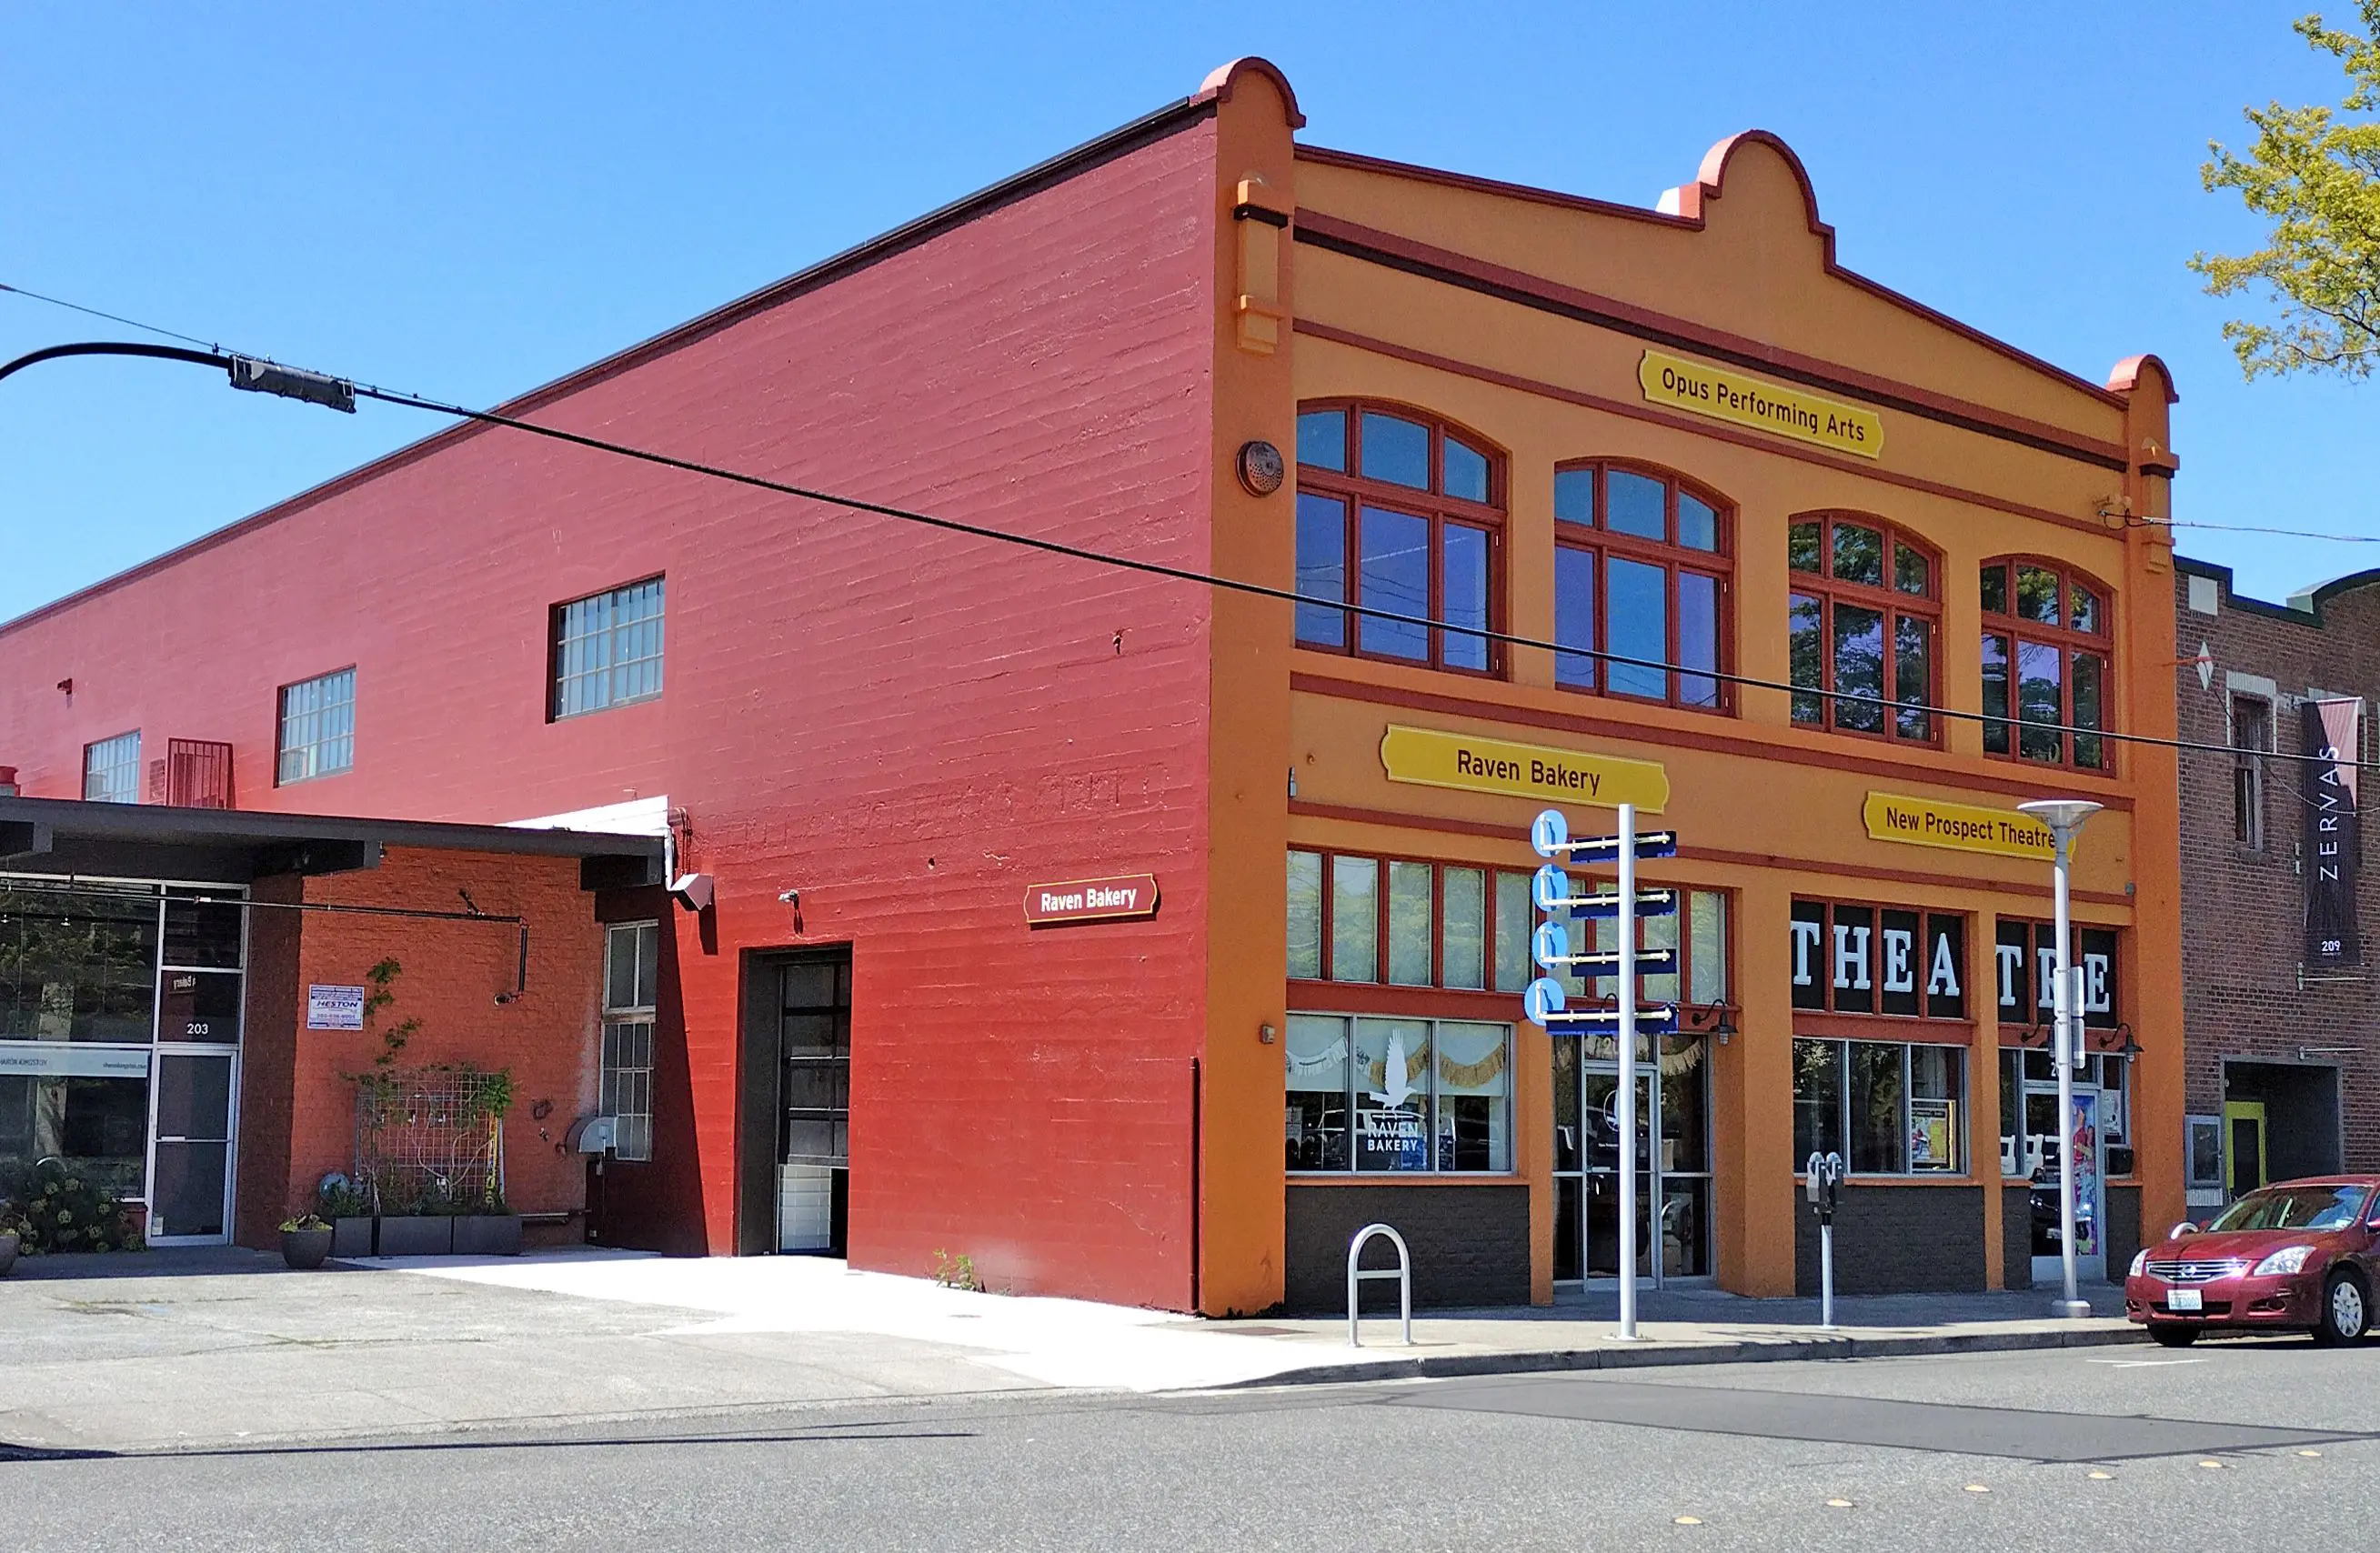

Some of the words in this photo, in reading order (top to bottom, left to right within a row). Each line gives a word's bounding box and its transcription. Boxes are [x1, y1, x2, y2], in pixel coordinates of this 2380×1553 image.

[1662, 367, 1710, 400] Opus
[1717, 382, 1818, 435] Performing
[1826, 413, 1865, 442] Arts
[1457, 748, 1521, 781] Raven
[1531, 759, 1601, 797] Bakery
[2318, 746, 2340, 881] ZERVAS
[1886, 807, 1920, 831] New
[1925, 812, 1993, 841] Prospect
[1998, 821, 2056, 849] Theatre
[1040, 892, 1083, 913] Raven
[1086, 885, 1138, 910] Bakery
[2321, 940, 2341, 952] 209
[186, 1023, 209, 1035] 203
[1367, 1121, 1419, 1138] RAVEN
[1367, 1138, 1419, 1152] BAKERY
